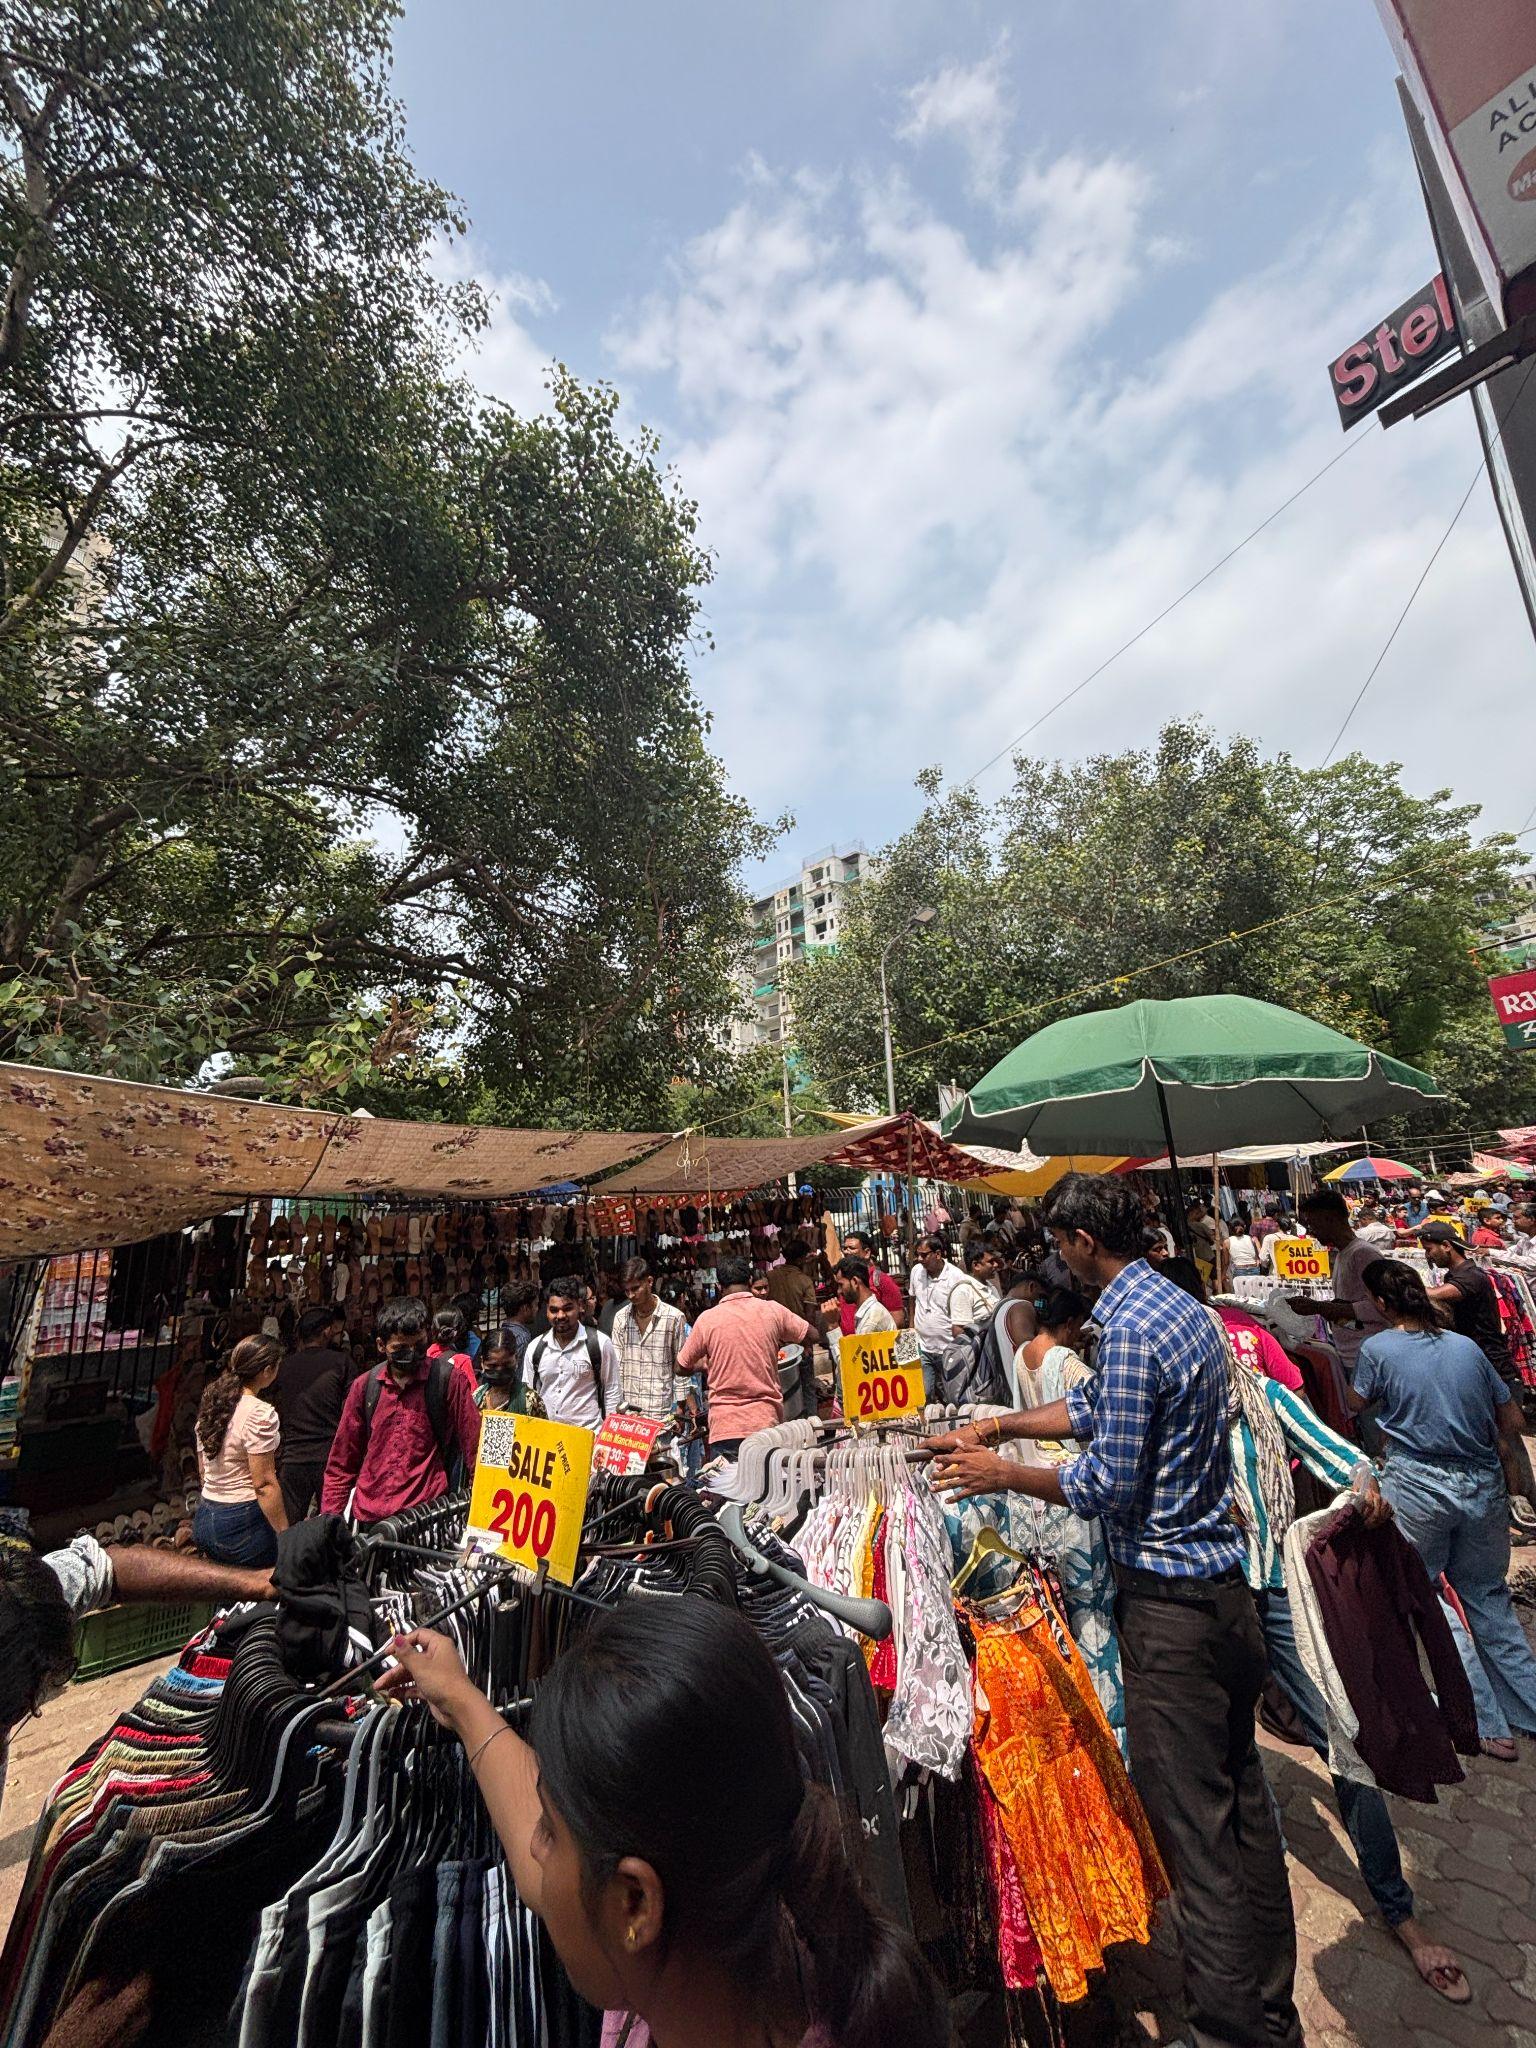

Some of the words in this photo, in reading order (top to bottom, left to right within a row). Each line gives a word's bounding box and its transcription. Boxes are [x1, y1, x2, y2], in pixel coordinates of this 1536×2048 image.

[1499, 990, 1536, 1015] Ra
[1288, 1246, 1313, 1258] SALE
[1285, 1259, 1320, 1275] 100
[861, 1347, 899, 1375] SALE
[857, 1374, 909, 1416] 200
[609, 1418, 620, 1432] Veg
[619, 1420, 636, 1433] Fried
[508, 1441, 556, 1490] SALE
[560, 1453, 571, 1475] PRICE
[487, 1488, 557, 1558] 200
